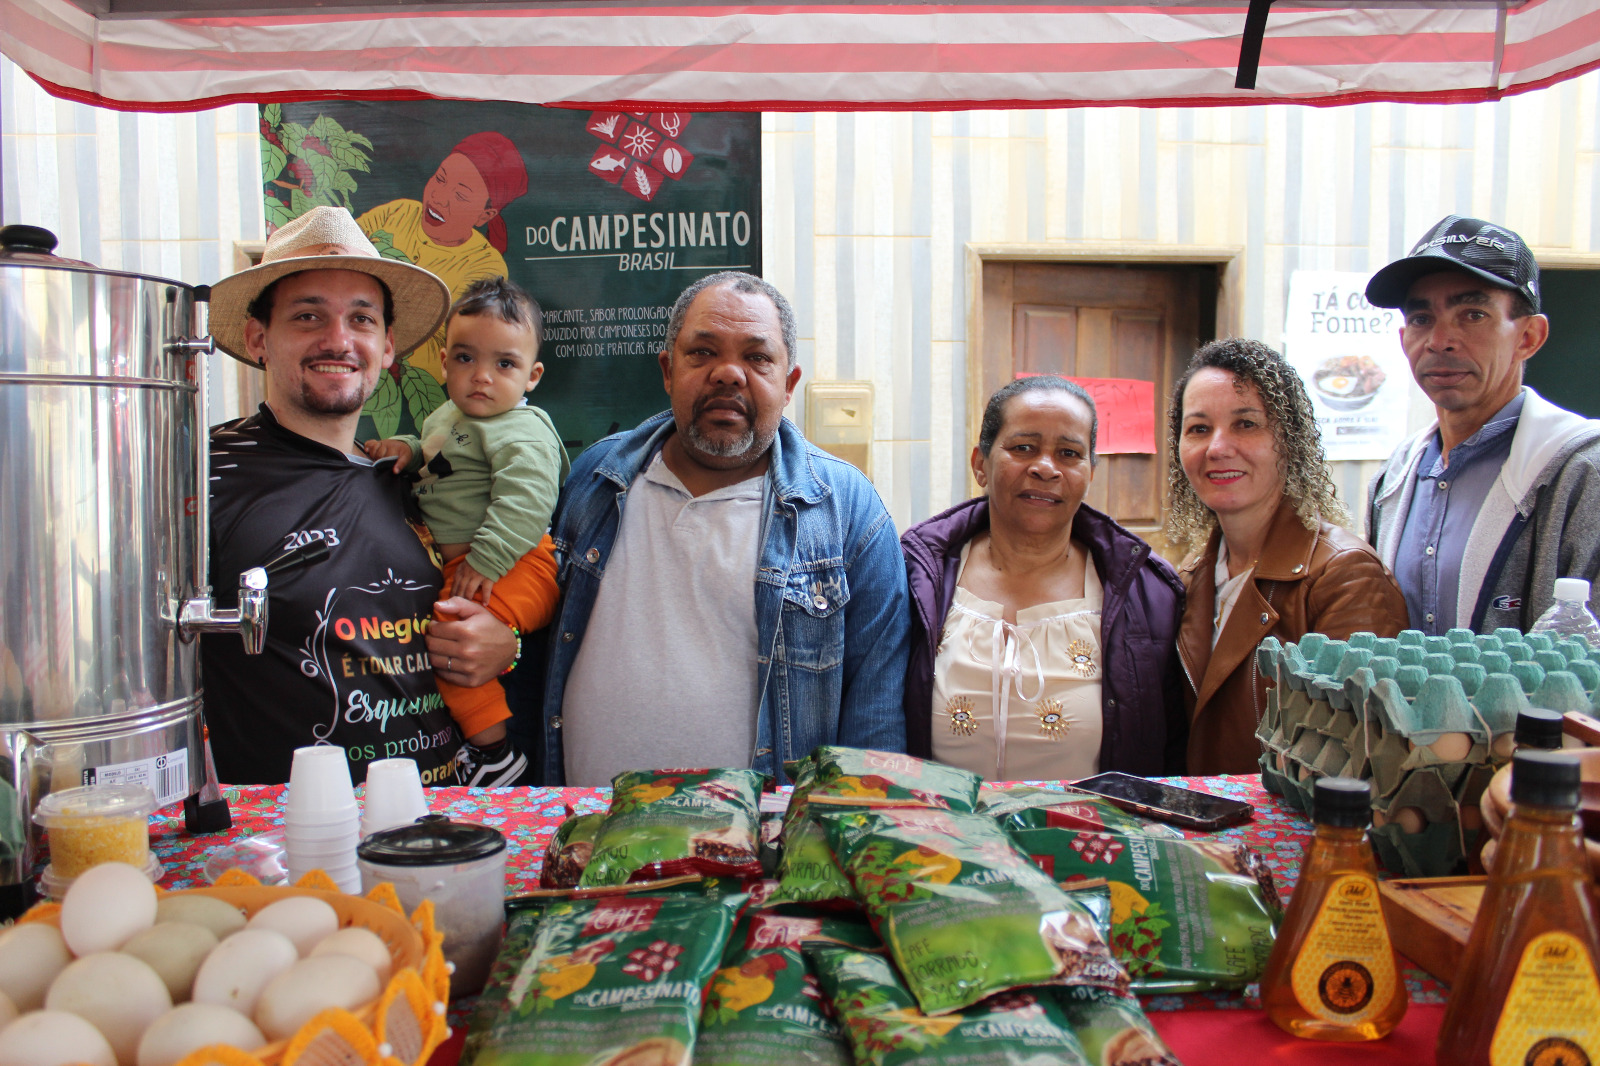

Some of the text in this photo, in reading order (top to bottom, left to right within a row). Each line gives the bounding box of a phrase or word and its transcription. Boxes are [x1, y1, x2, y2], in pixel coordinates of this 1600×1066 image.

[526, 211, 751, 252] DO CAMPESINATO
[618, 252, 676, 271] BRASIL
[1312, 285, 1339, 311] TÁ
[541, 309, 588, 324] MARCANTE,
[590, 307, 616, 322] SABOR
[1310, 311, 1394, 334] Fome?
[542, 327, 579, 341] ODUZIDO
[580, 326, 596, 340] POR
[598, 324, 651, 339] CAMPONESES
[555, 344, 575, 358] COM
[577, 343, 592, 357] USO
[595, 342, 606, 357] DE
[335, 617, 356, 640] O
[342, 652, 355, 678] É
[348, 745, 376, 761] os
